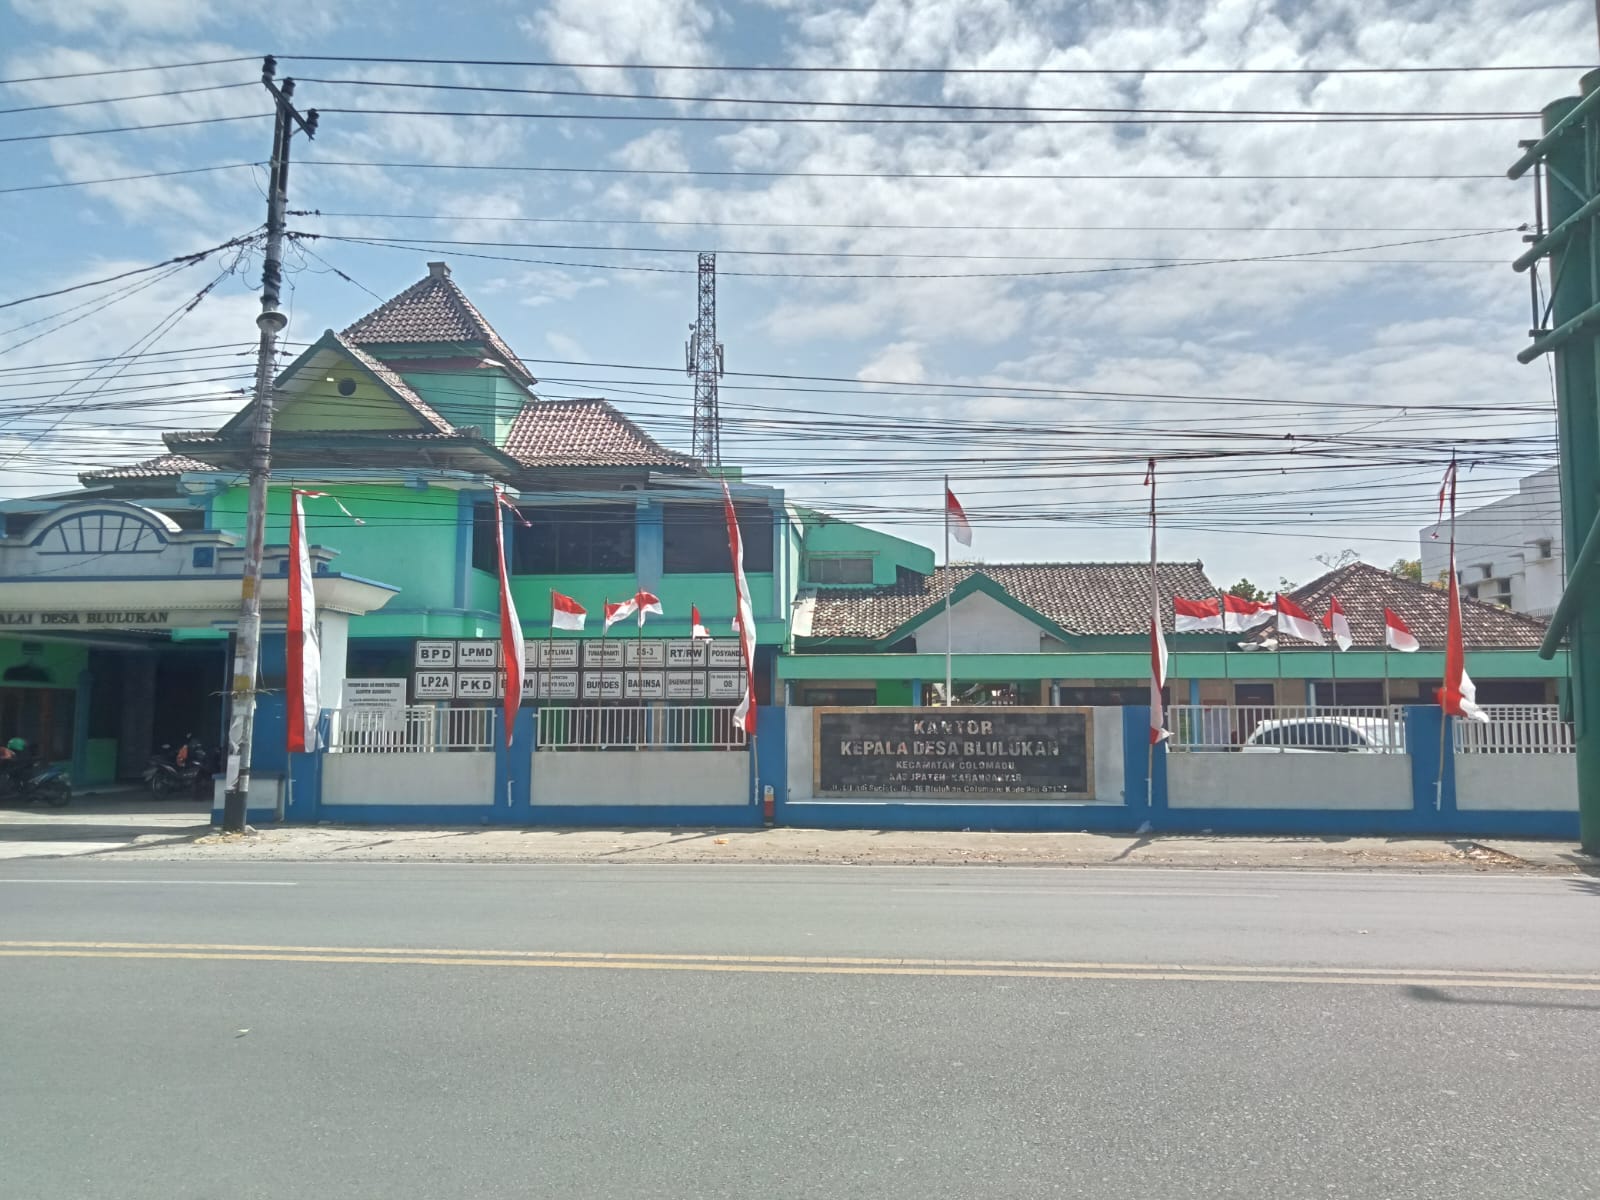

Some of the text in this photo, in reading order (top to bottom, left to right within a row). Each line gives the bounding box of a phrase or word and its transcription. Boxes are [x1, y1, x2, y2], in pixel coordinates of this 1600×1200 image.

[41, 612, 80, 625] DESA
[87, 611, 169, 624] BLULUKAN
[420, 649, 451, 660] BPD
[461, 648, 493, 657] LPMD
[670, 649, 703, 658] RT/RW
[421, 676, 449, 688] LP2A
[460, 680, 492, 690] PKD
[723, 680, 733, 688] 08
[913, 719, 993, 735] KANTOR
[840, 740, 1059, 756] KEPALA DESA BLULUKAN
[896, 760, 1015, 770] KECAMATAN COLOMADU
